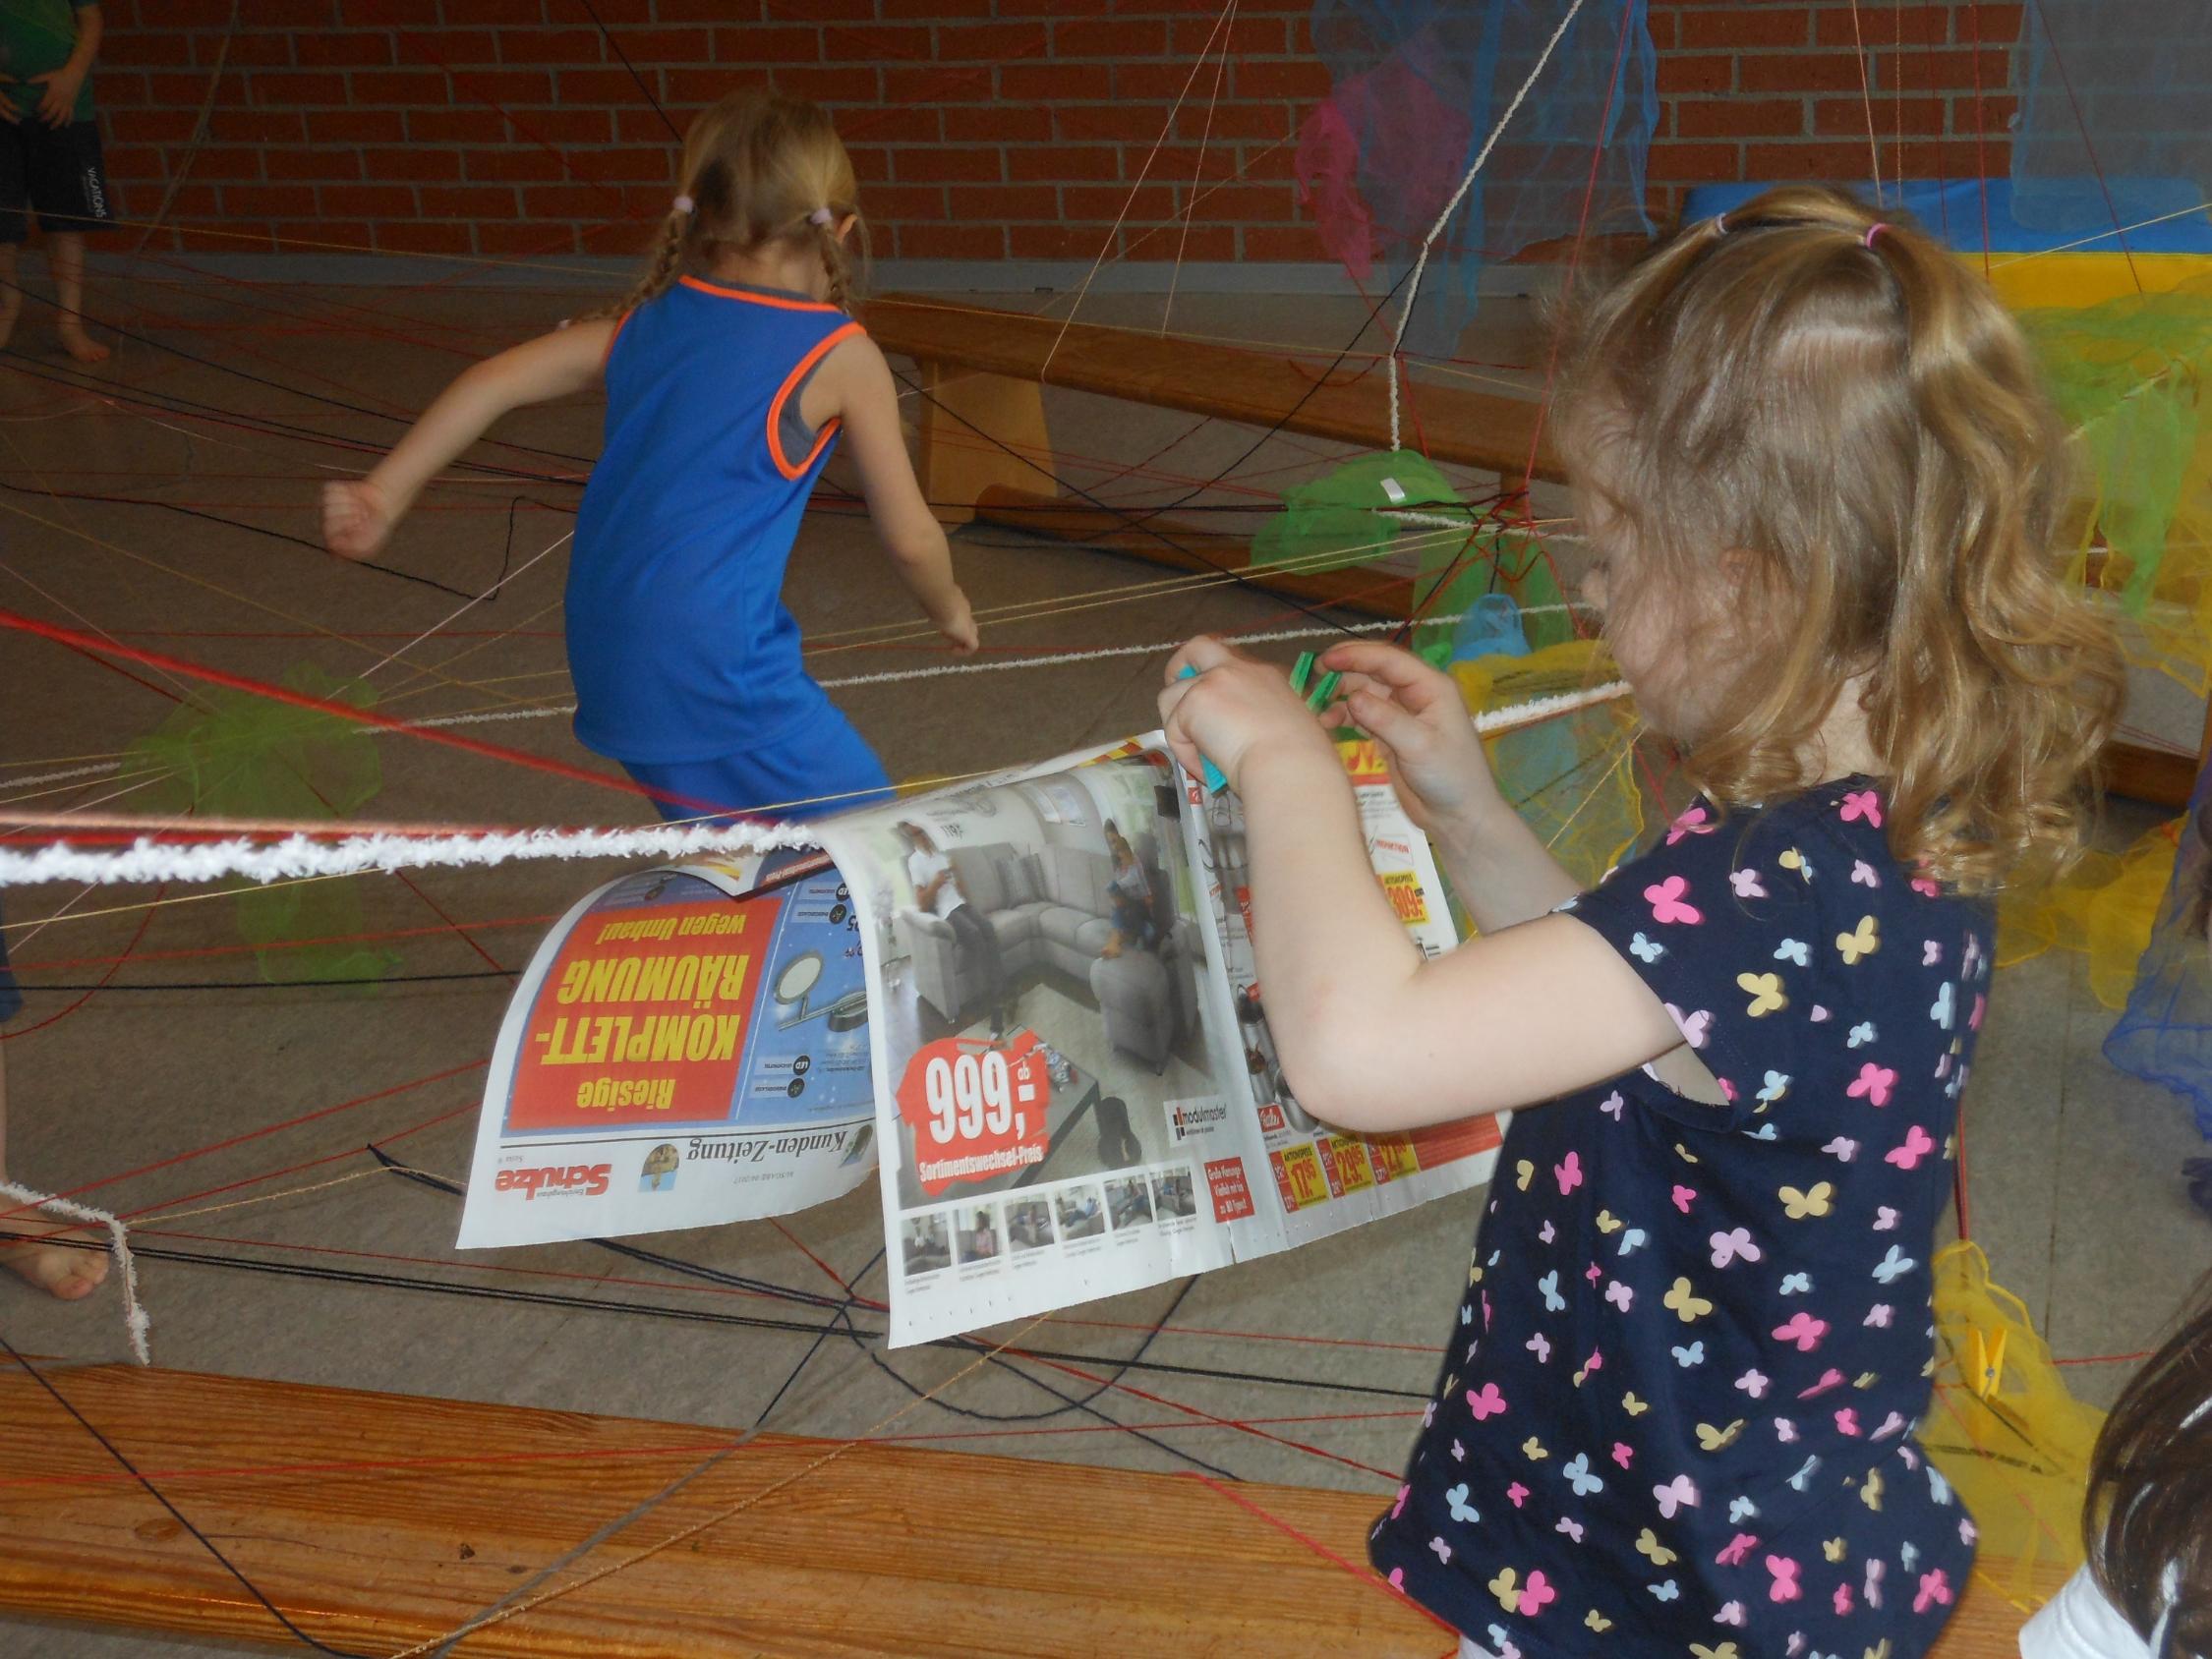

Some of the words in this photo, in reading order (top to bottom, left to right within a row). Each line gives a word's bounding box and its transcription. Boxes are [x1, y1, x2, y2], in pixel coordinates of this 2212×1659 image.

[87, 166, 107, 218] VACATIONS
[596, 918, 677, 945] Umbau!
[677, 914, 746, 937] wegen
[557, 954, 750, 1008] RÄUMUNG
[535, 1015, 740, 1065] KOMPLETT-
[577, 1077, 675, 1113] Riesige
[1183, 1104, 1227, 1125] modulmaster
[686, 1130, 848, 1164] Kunden-Zeitung
[919, 1143, 1044, 1182] Sortimentswechsel-Preis
[495, 1163, 611, 1201] Schulze
